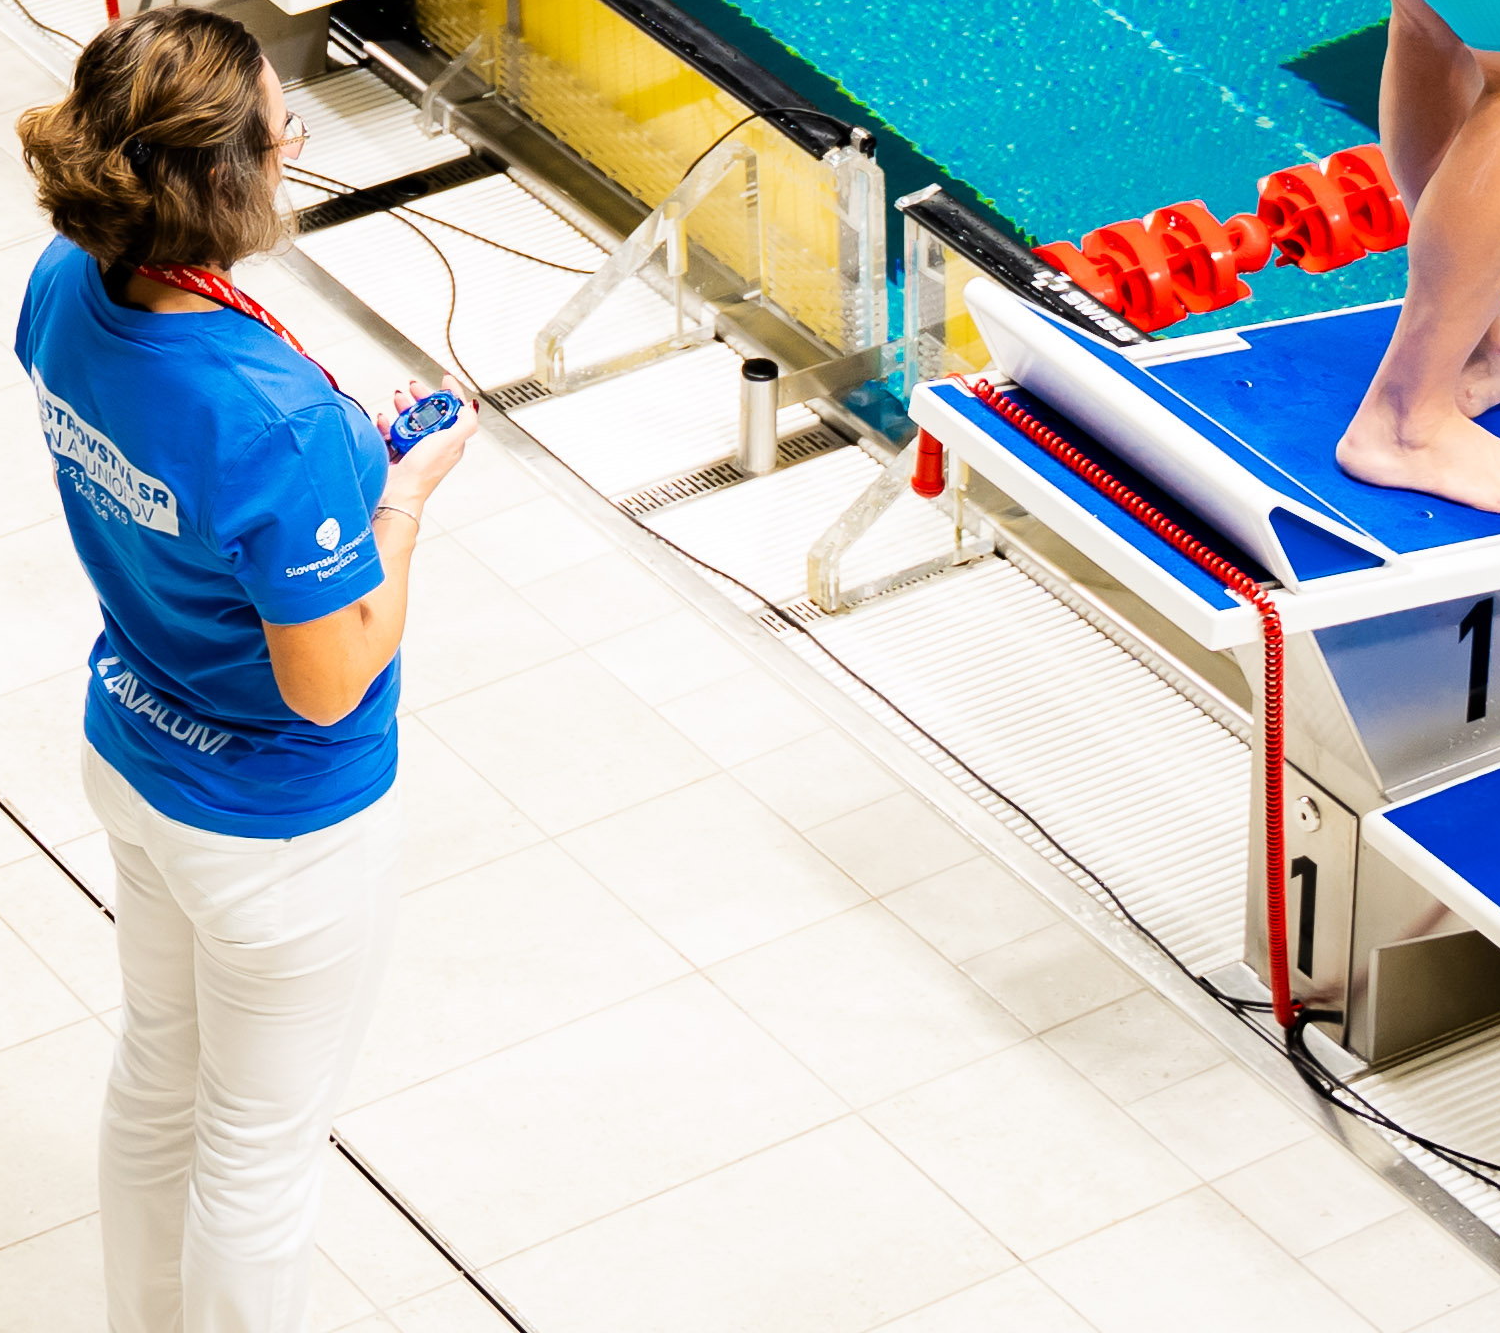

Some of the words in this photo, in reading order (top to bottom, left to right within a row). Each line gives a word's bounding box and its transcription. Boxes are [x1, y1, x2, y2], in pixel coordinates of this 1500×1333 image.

[1058, 290, 1140, 342] SWISS
[138, 482, 169, 509] SR
[1458, 596, 1494, 723] 1
[1291, 855, 1317, 980] 1
